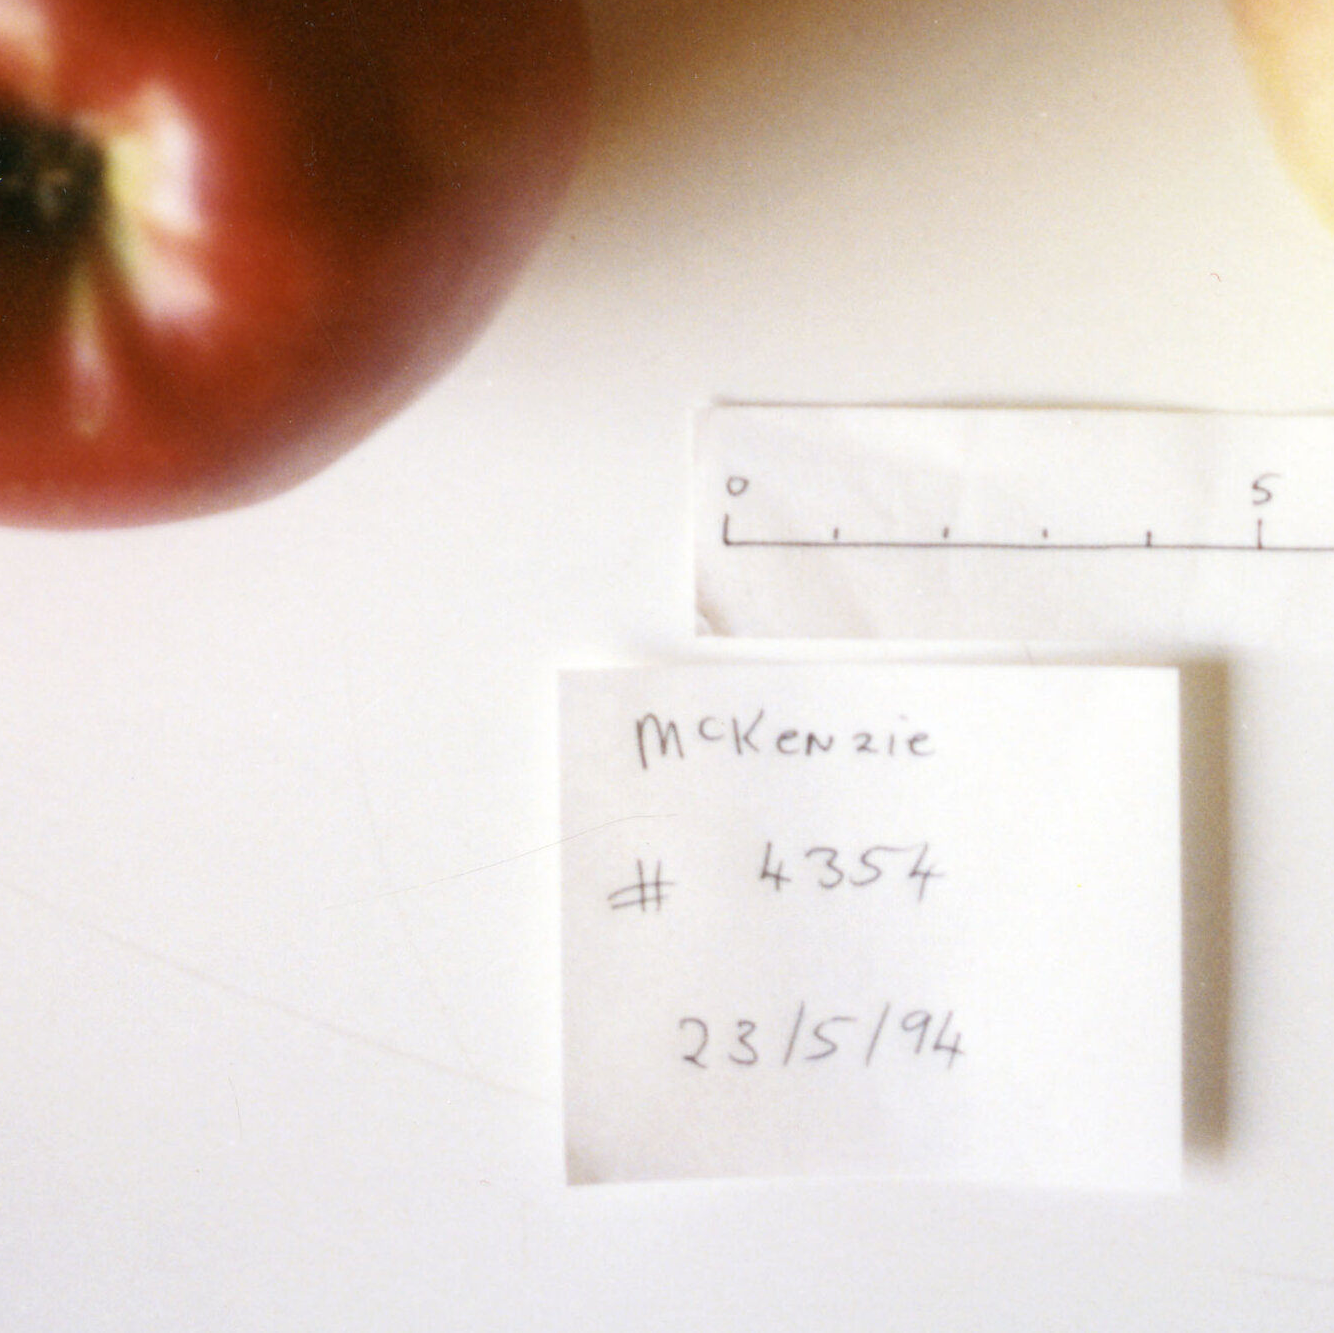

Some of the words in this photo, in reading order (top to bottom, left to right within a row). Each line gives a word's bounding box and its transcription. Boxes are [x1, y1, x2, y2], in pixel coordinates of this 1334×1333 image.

[1252, 472, 1278, 505] 5
[608, 860, 676, 912] #
[759, 841, 946, 903] 4354
[679, 1002, 965, 1069] 23/5/94
